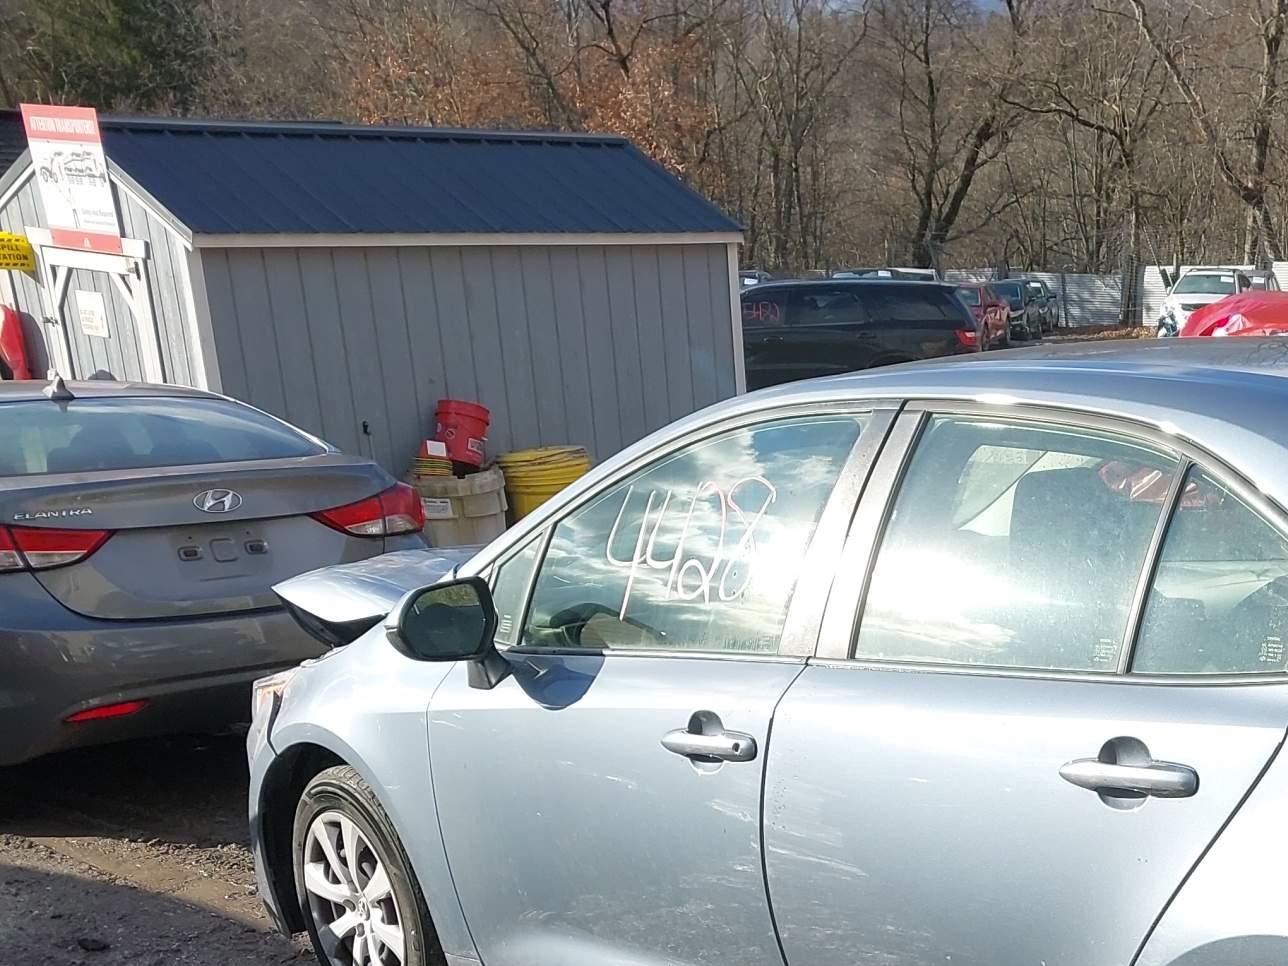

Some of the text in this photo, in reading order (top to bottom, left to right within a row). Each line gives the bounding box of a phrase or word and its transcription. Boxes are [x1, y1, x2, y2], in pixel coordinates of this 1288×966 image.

[0, 244, 20, 252] PILL
[13, 507, 94, 520] ELANTRA
[605, 475, 777, 622] 4428
